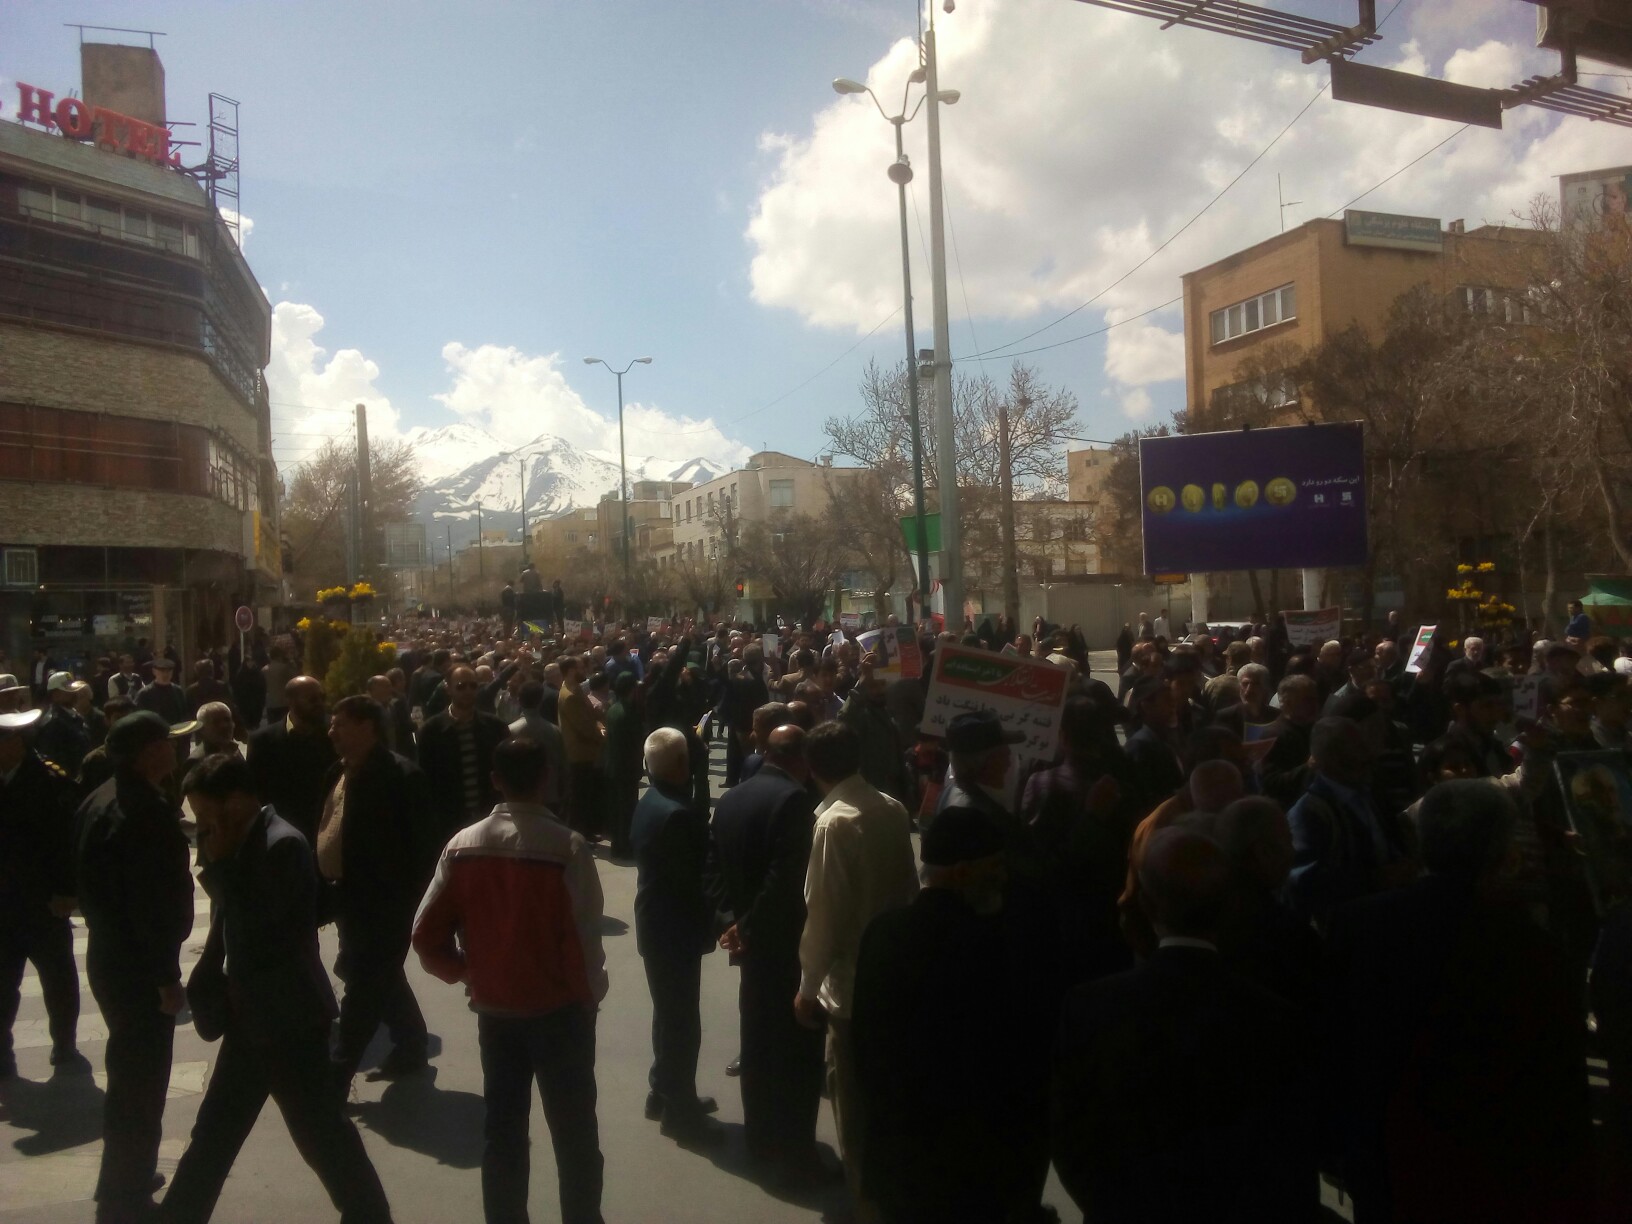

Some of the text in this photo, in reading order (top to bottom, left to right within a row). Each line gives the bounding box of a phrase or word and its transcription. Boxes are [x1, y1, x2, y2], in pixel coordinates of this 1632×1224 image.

[16, 81, 181, 166] HOTEL
[935, 694, 951, 706] باد
[930, 713, 946, 725] باد
